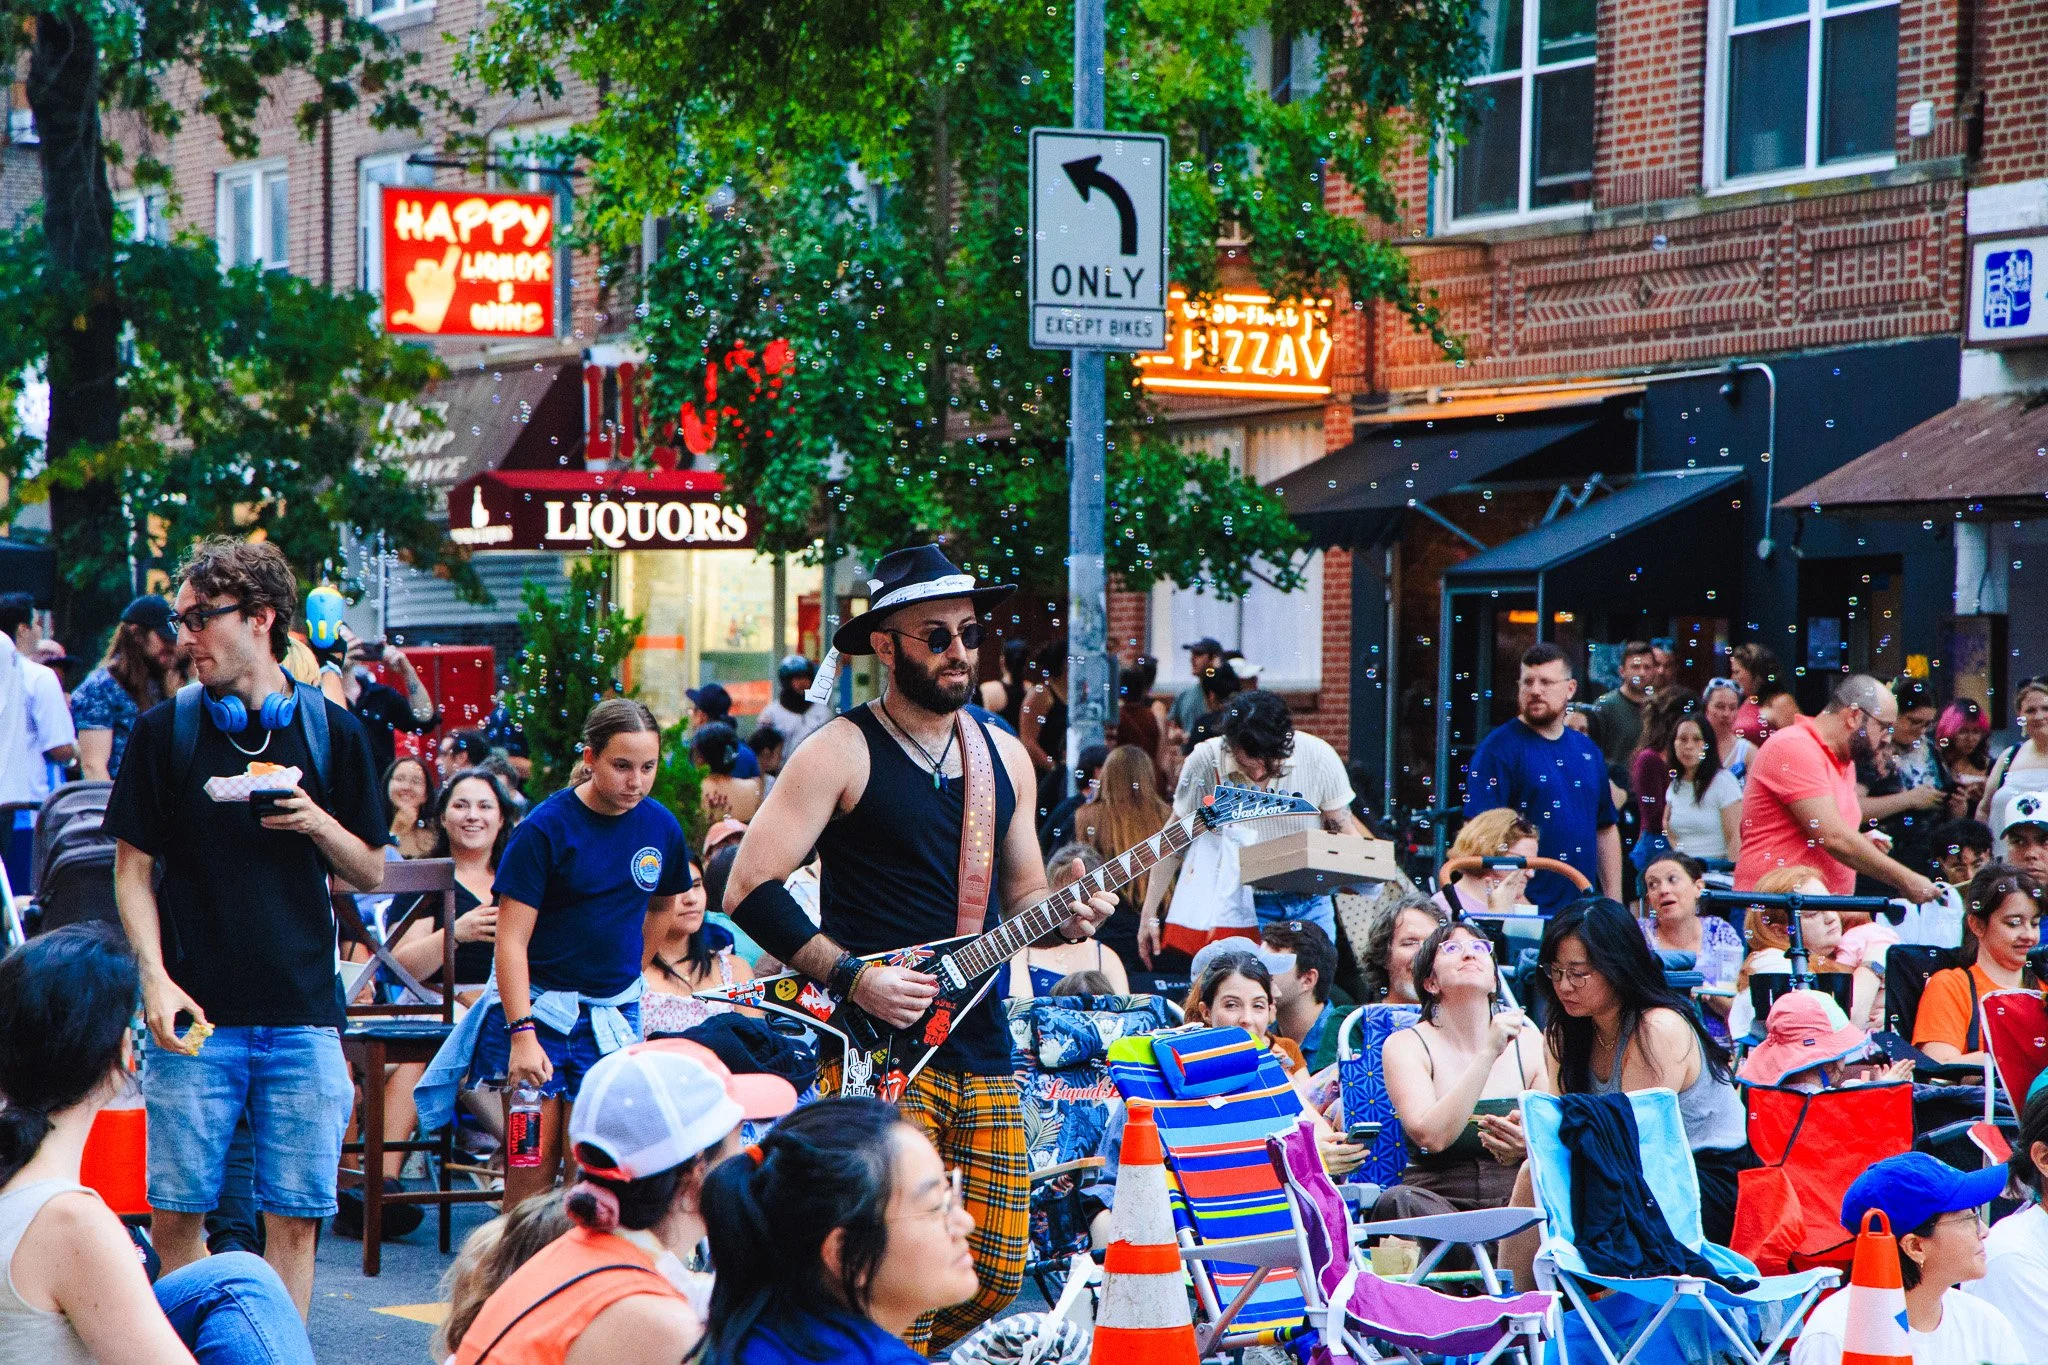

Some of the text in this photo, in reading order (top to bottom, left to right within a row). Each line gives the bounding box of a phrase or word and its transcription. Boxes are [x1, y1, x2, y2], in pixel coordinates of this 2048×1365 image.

[394, 198, 550, 247] HAPPY
[460, 251, 552, 282] LIQUOR
[1052, 264, 1144, 298] ONLY
[1045, 316, 1153, 338] EXCEPT BIKES
[545, 501, 748, 548] LIQUORS
[1231, 802, 1290, 819] Jackson
[844, 1084, 875, 1097] METAL
[1044, 1078, 1103, 1105] Liquid
